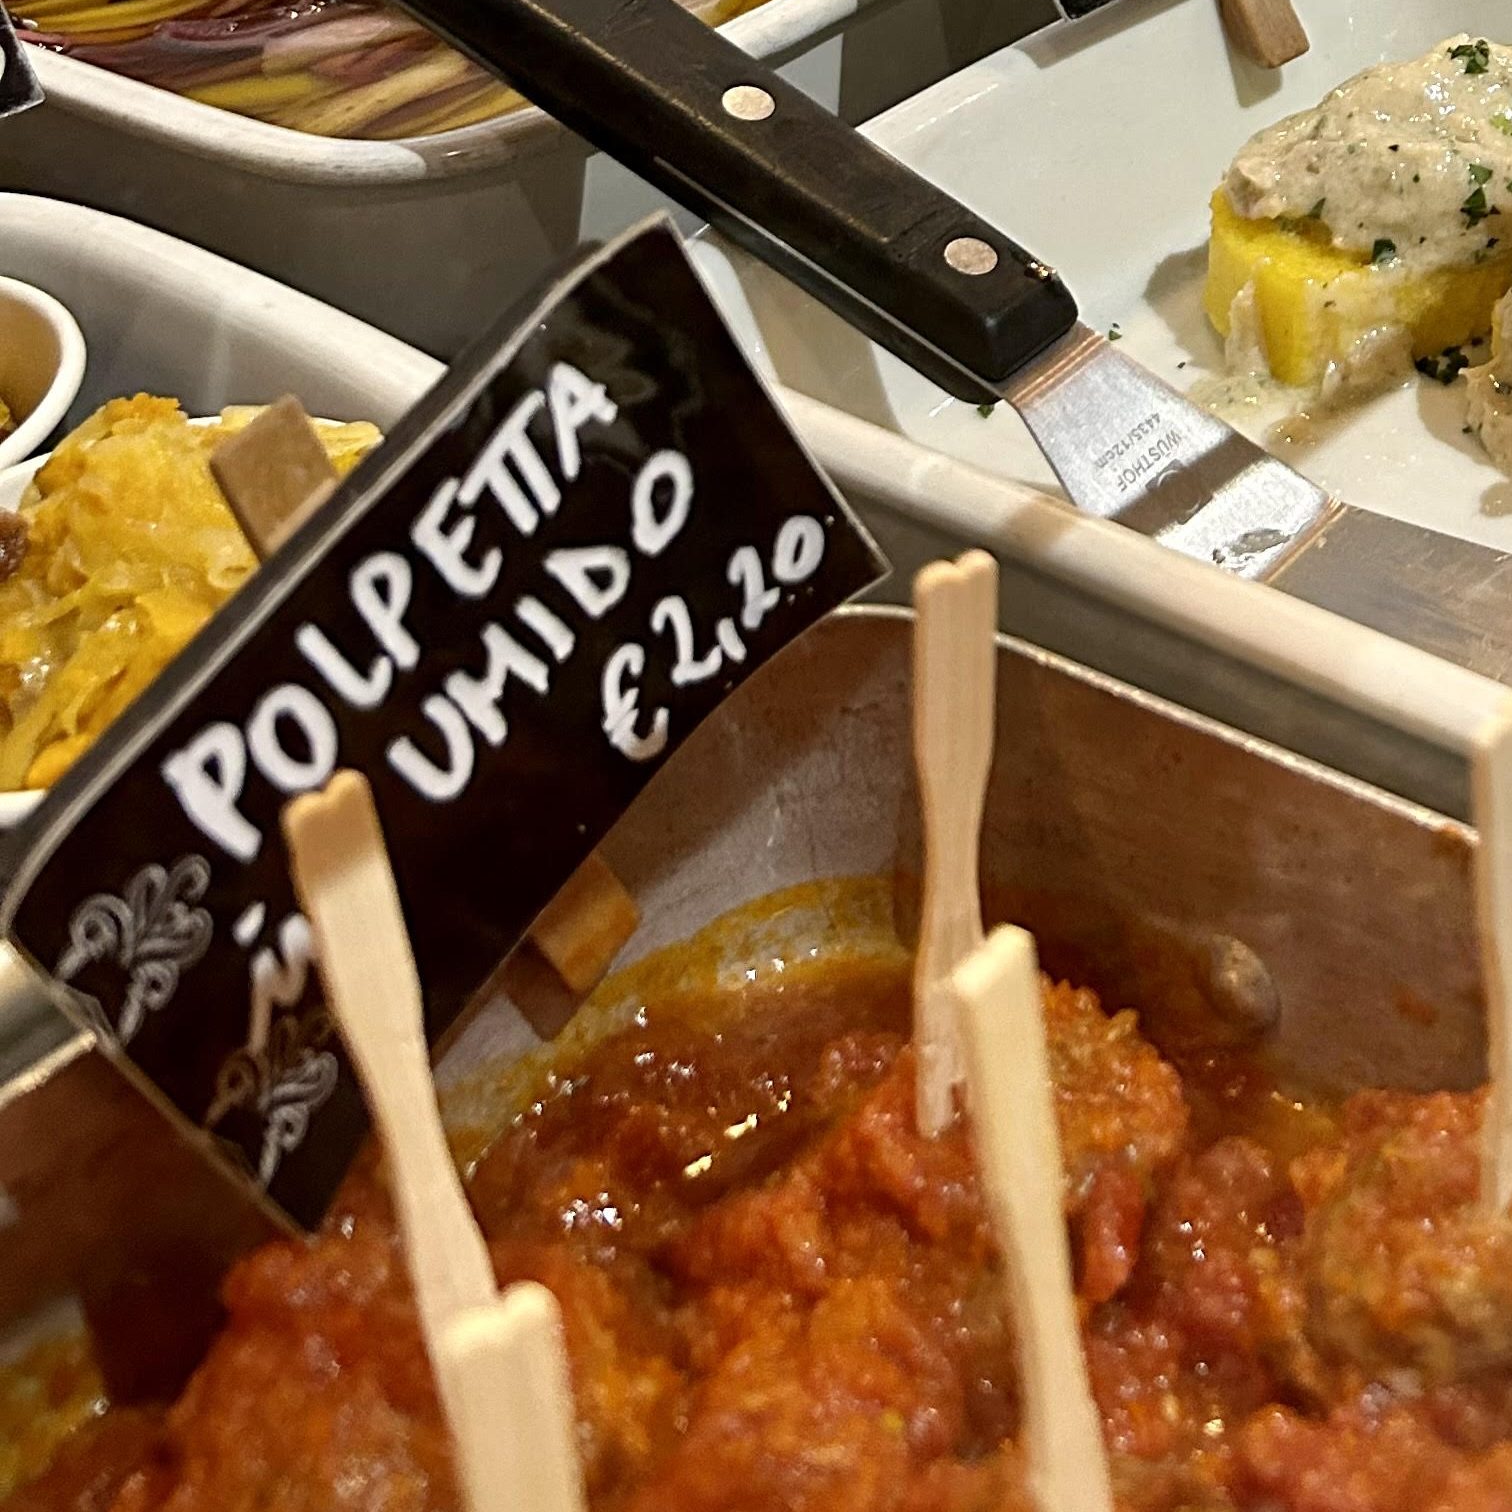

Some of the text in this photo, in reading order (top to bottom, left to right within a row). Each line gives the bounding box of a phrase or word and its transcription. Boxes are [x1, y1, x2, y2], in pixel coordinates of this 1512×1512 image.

[161, 362, 618, 862] POLPETTA
[388, 448, 692, 802] UMIDO
[1116, 427, 1183, 493] WÜSTHOF
